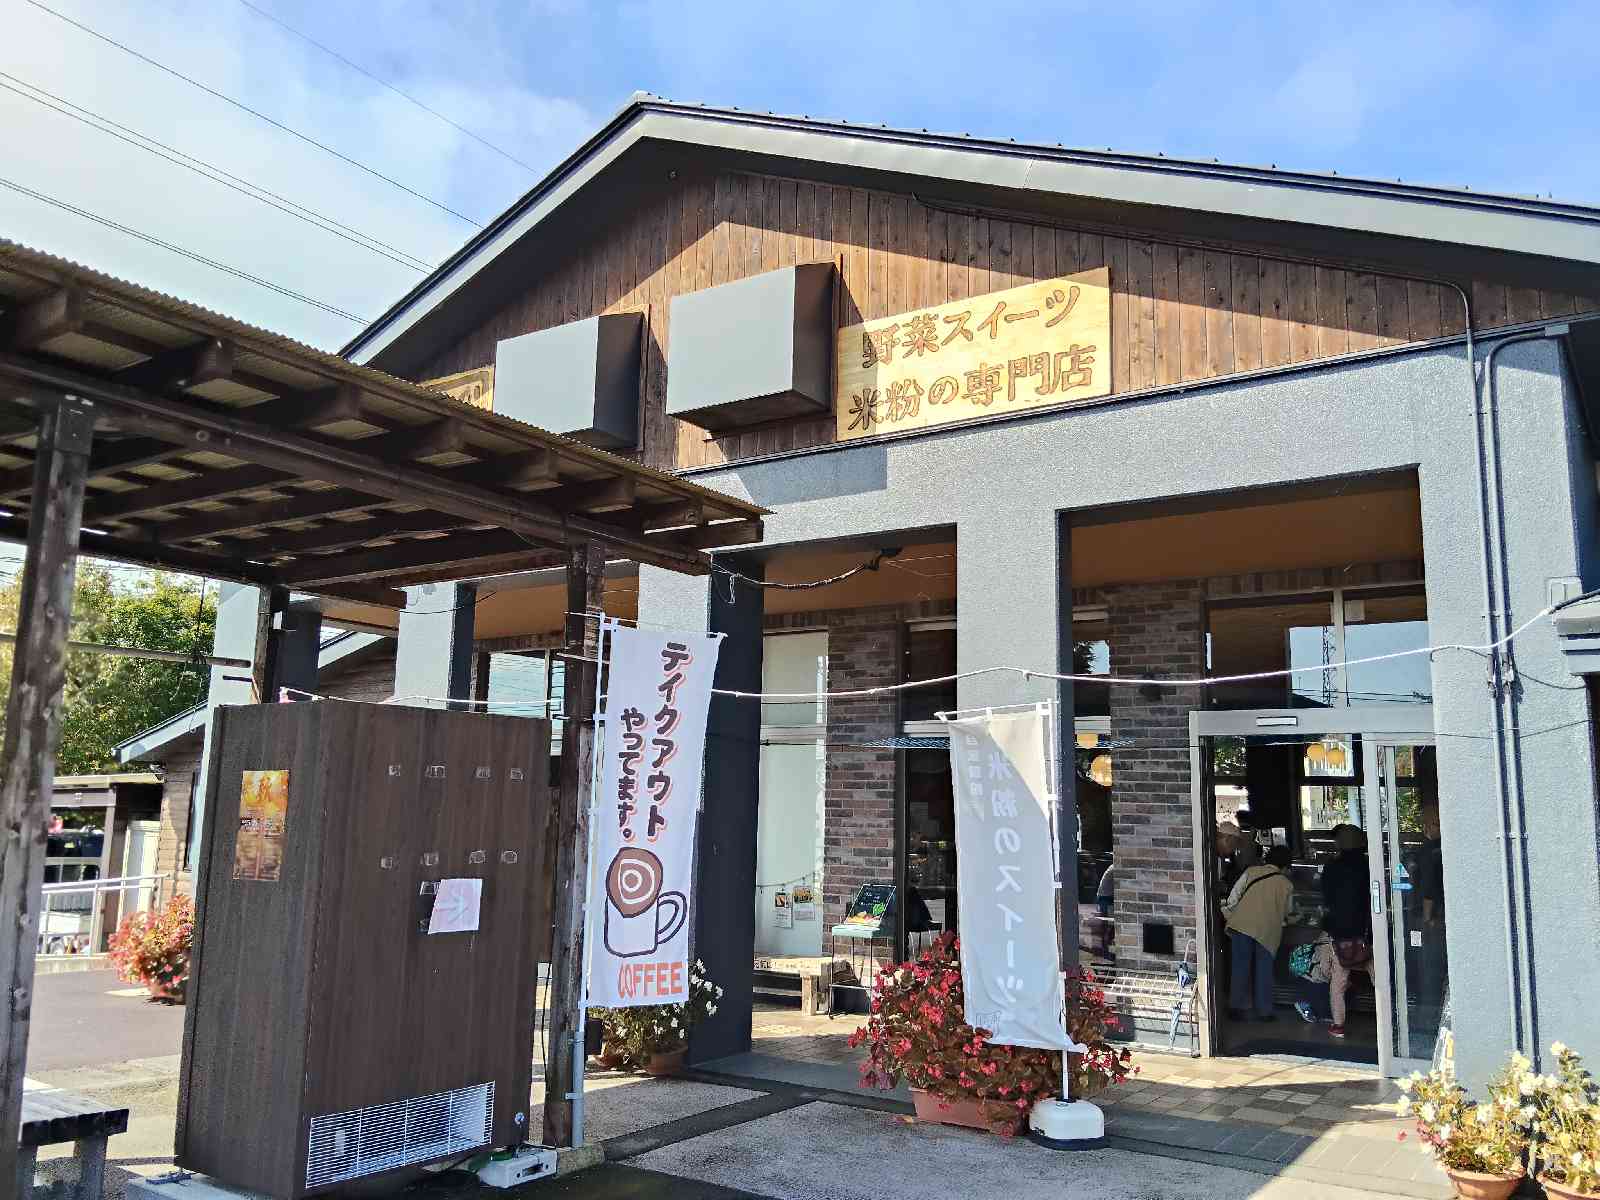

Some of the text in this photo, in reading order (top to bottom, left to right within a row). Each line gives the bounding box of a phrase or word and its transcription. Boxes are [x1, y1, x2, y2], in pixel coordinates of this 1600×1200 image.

[862, 285, 1081, 369] 野菜スイーツ
[848, 343, 1097, 431] 米粉の専門店
[617, 706, 645, 840] やってます。
[646, 641, 691, 840] テイクアウト
[617, 961, 683, 999] COFFEE
